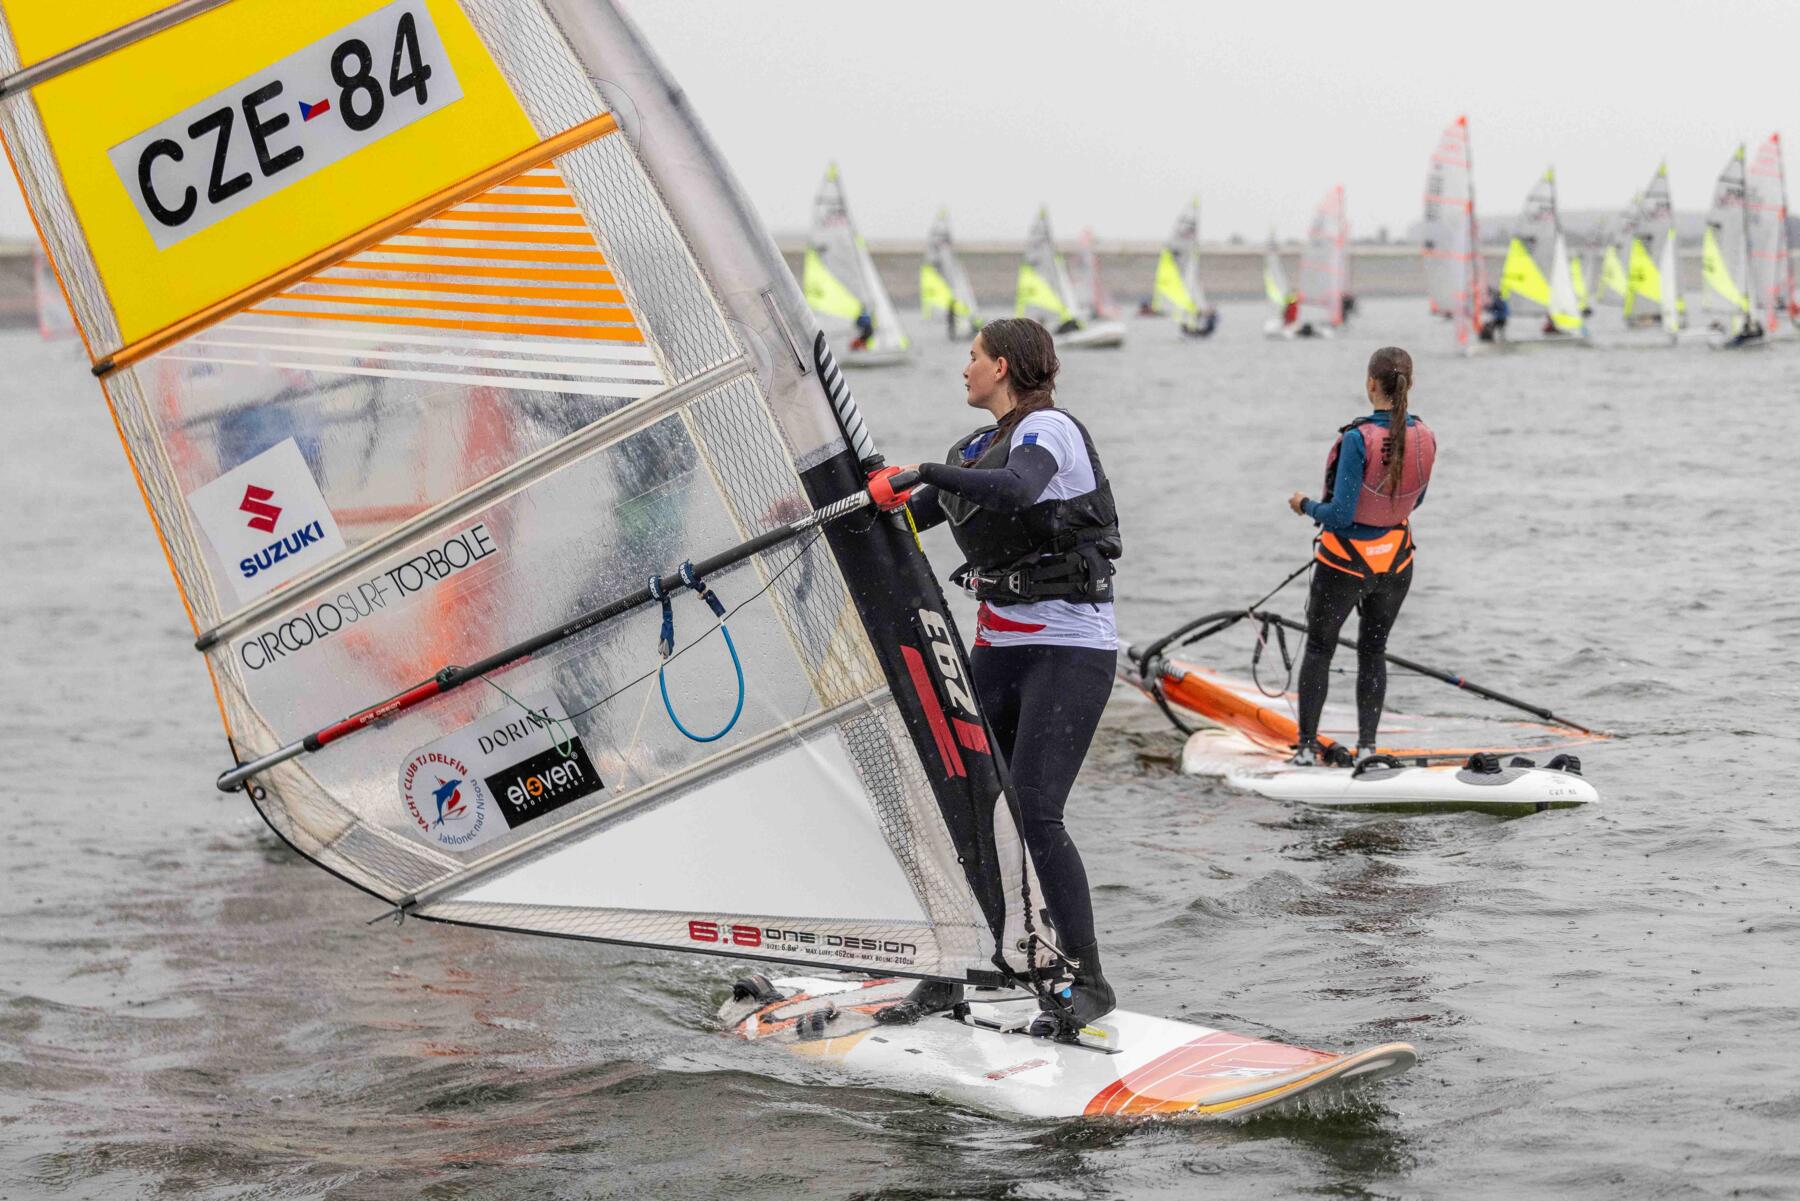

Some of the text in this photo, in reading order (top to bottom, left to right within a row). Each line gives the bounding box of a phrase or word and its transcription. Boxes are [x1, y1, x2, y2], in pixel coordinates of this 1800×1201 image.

[239, 520, 325, 578] SUZUKI
[385, 524, 497, 597] TORBOLE
[918, 608, 978, 716] 293
[478, 706, 552, 755] DORINT
[404, 762, 418, 791] CLUB
[416, 753, 427, 766] TJ
[507, 759, 582, 805] eleven
[515, 776, 586, 812] sportswear
[405, 794, 429, 833] YACHT
[438, 779, 485, 845] Jablonec nad Nisou
[688, 920, 762, 948] 6.8
[805, 948, 817, 956] MAX
